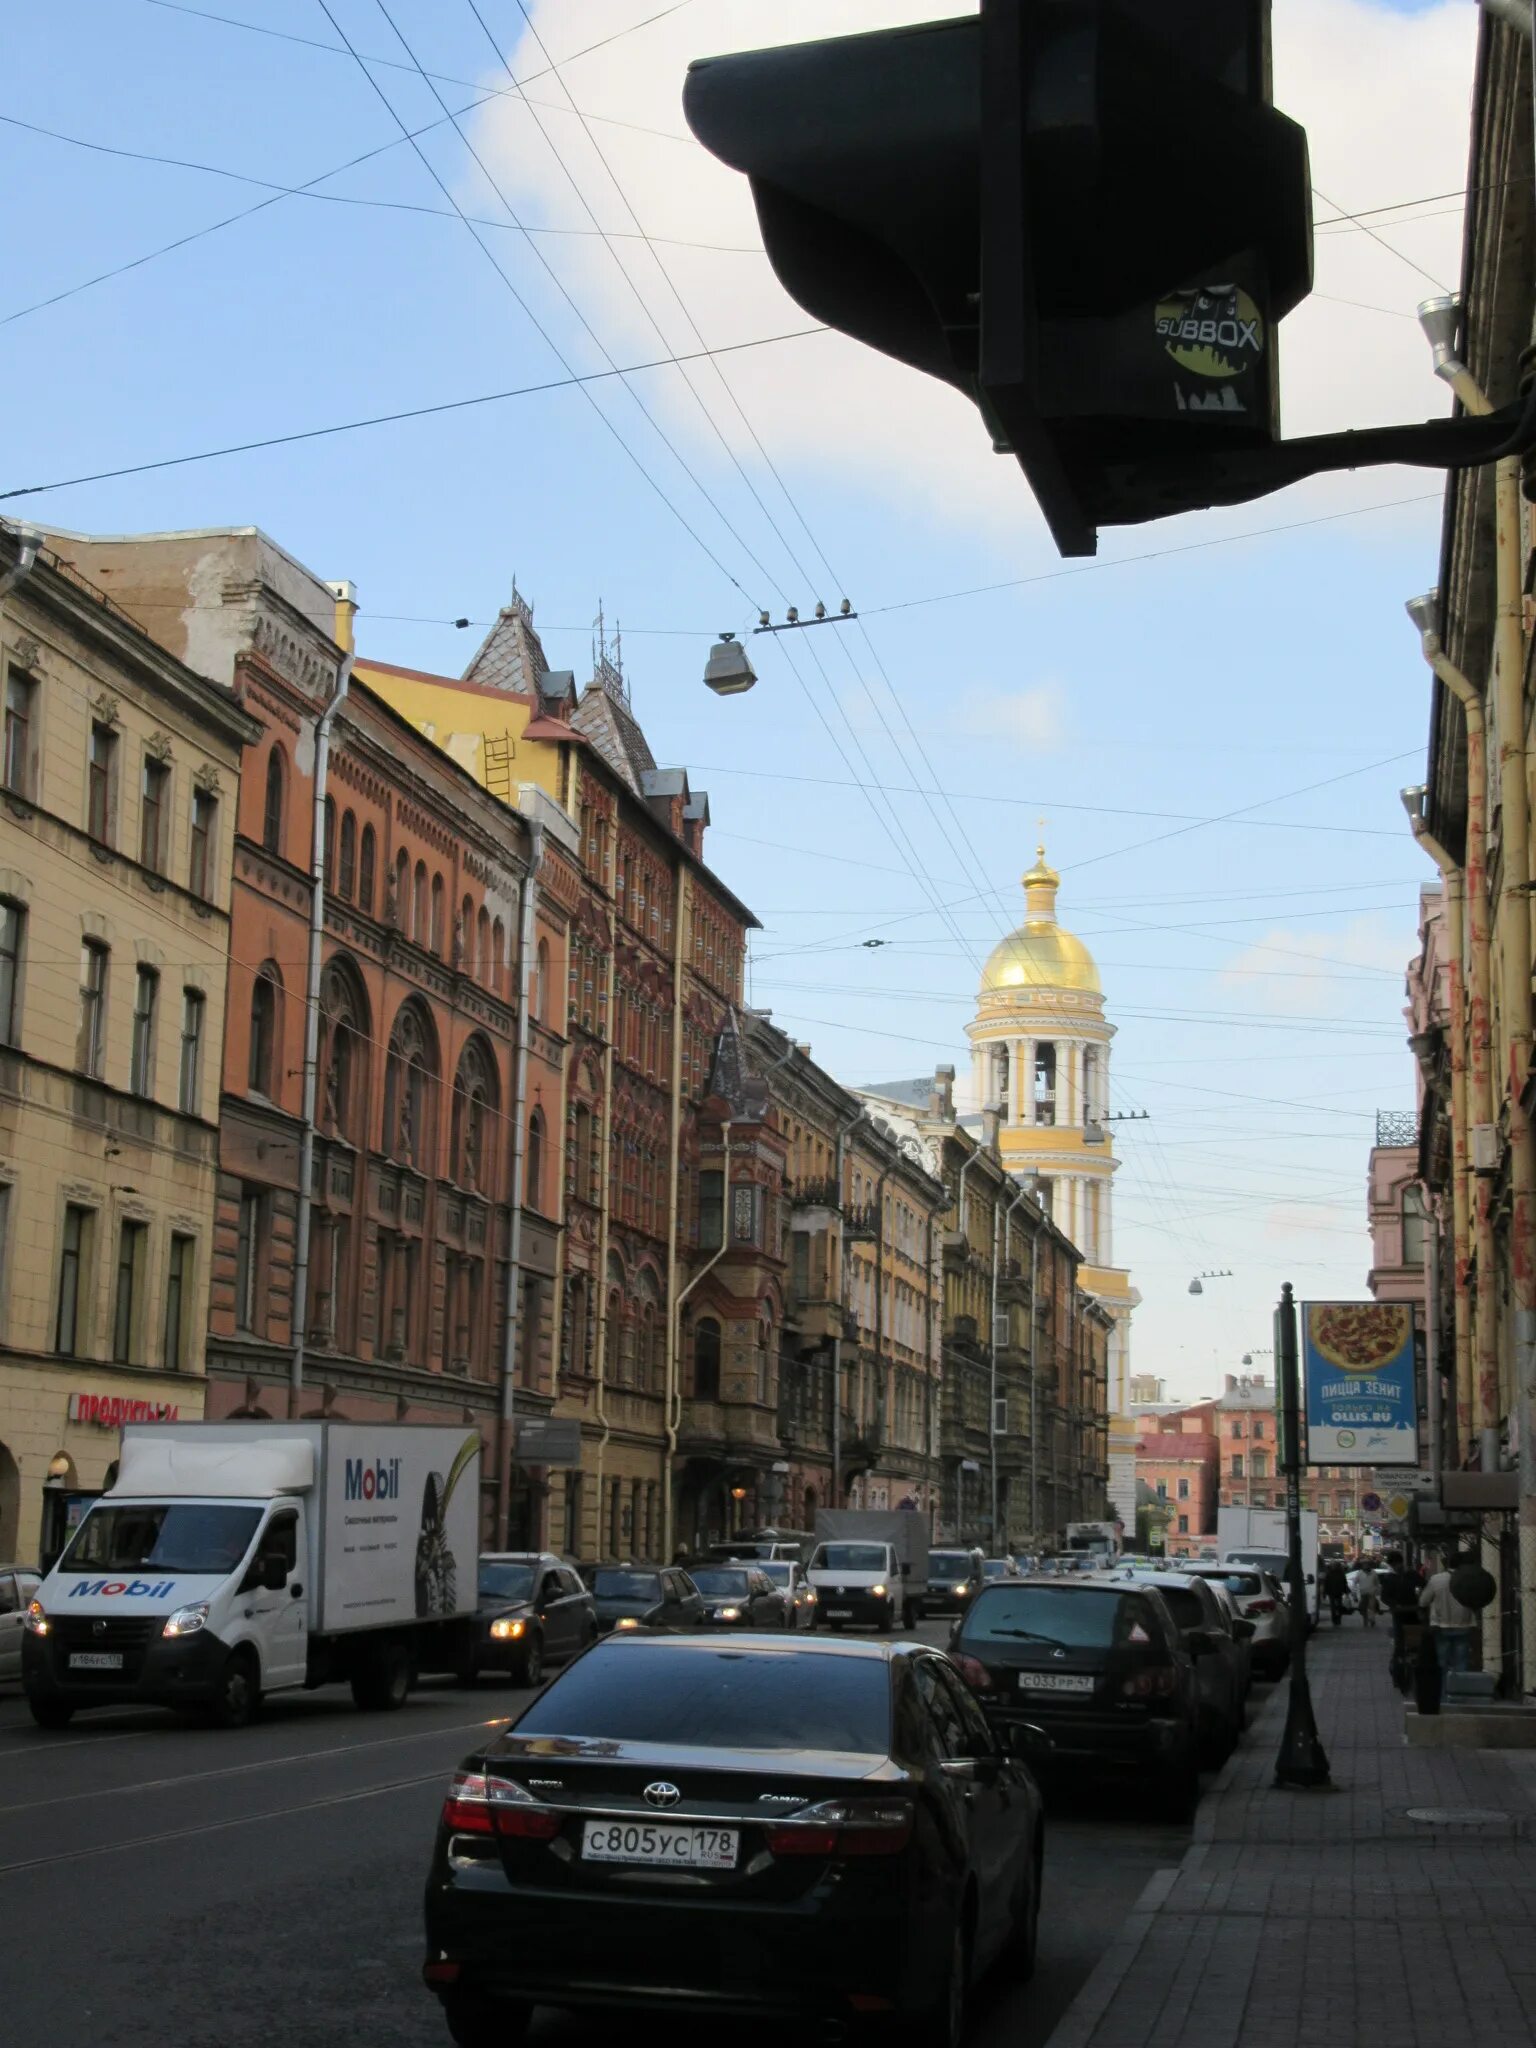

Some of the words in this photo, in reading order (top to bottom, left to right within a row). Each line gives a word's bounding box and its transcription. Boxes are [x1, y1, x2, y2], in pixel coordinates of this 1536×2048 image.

[1156, 319, 1260, 351] SUBBOX
[1321, 1381, 1360, 1399] ПИЦЦА
[1366, 1381, 1401, 1399] ЗЕНИТ
[1331, 1412, 1392, 1422] OLLIS.RU
[345, 1458, 399, 1500] Mobil
[68, 1580, 176, 1598] Mobil
[695, 1831, 732, 1851] 178
[701, 1851, 720, 1860] RUS
